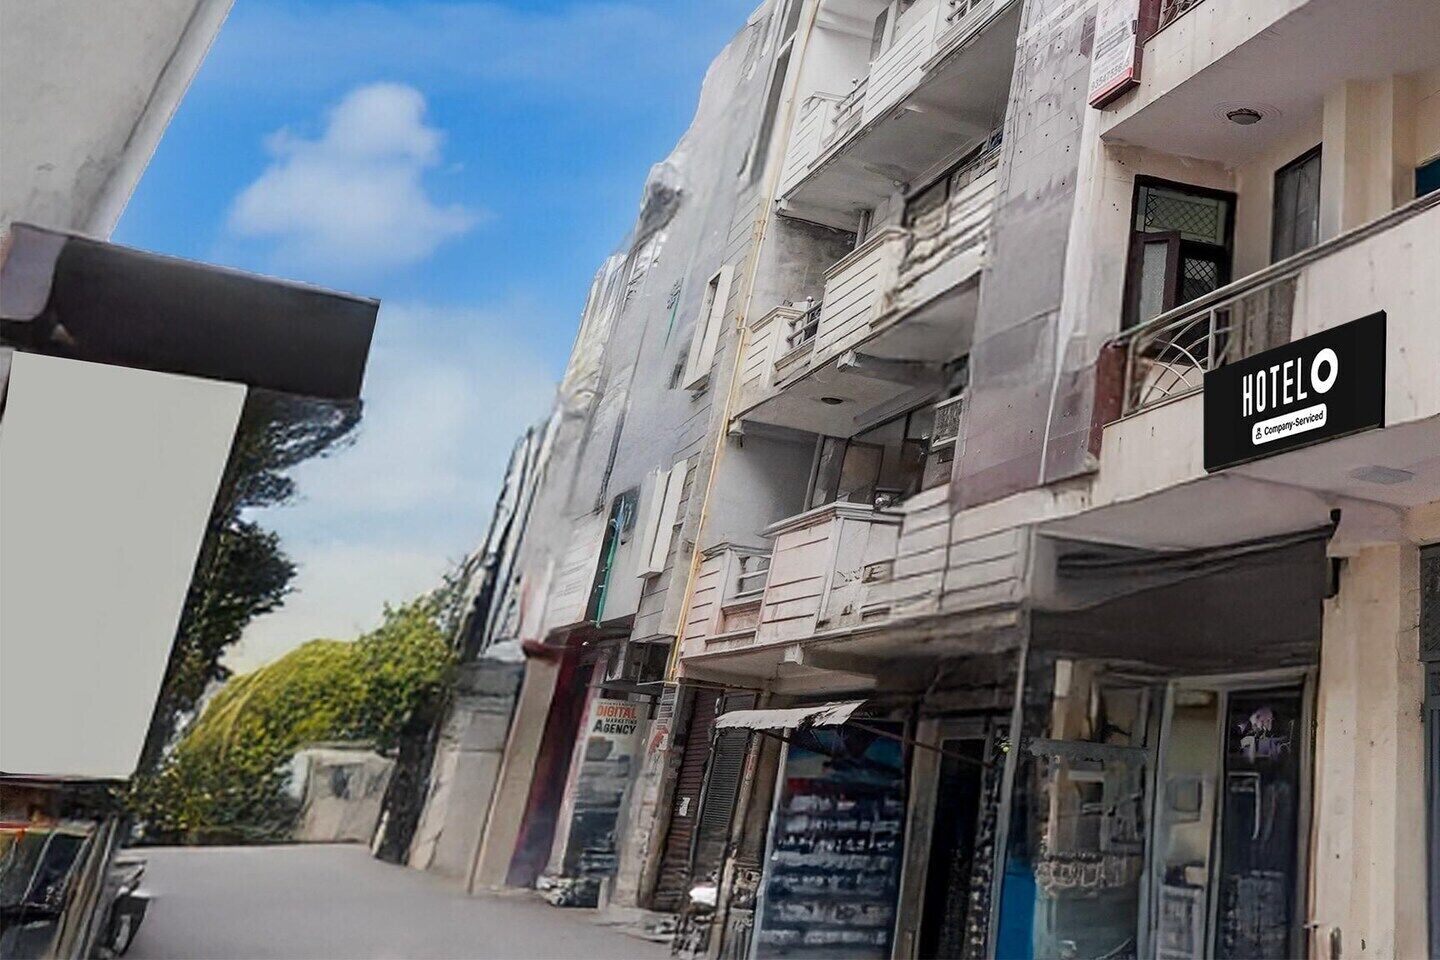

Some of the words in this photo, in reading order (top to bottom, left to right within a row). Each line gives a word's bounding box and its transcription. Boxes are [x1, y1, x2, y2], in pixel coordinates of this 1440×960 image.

[1242, 357, 1308, 417] HOTEL
[1264, 410, 1324, 435] Company-Serviced
[596, 705, 637, 718] DIGITAL
[593, 719, 637, 734] AGENCY
